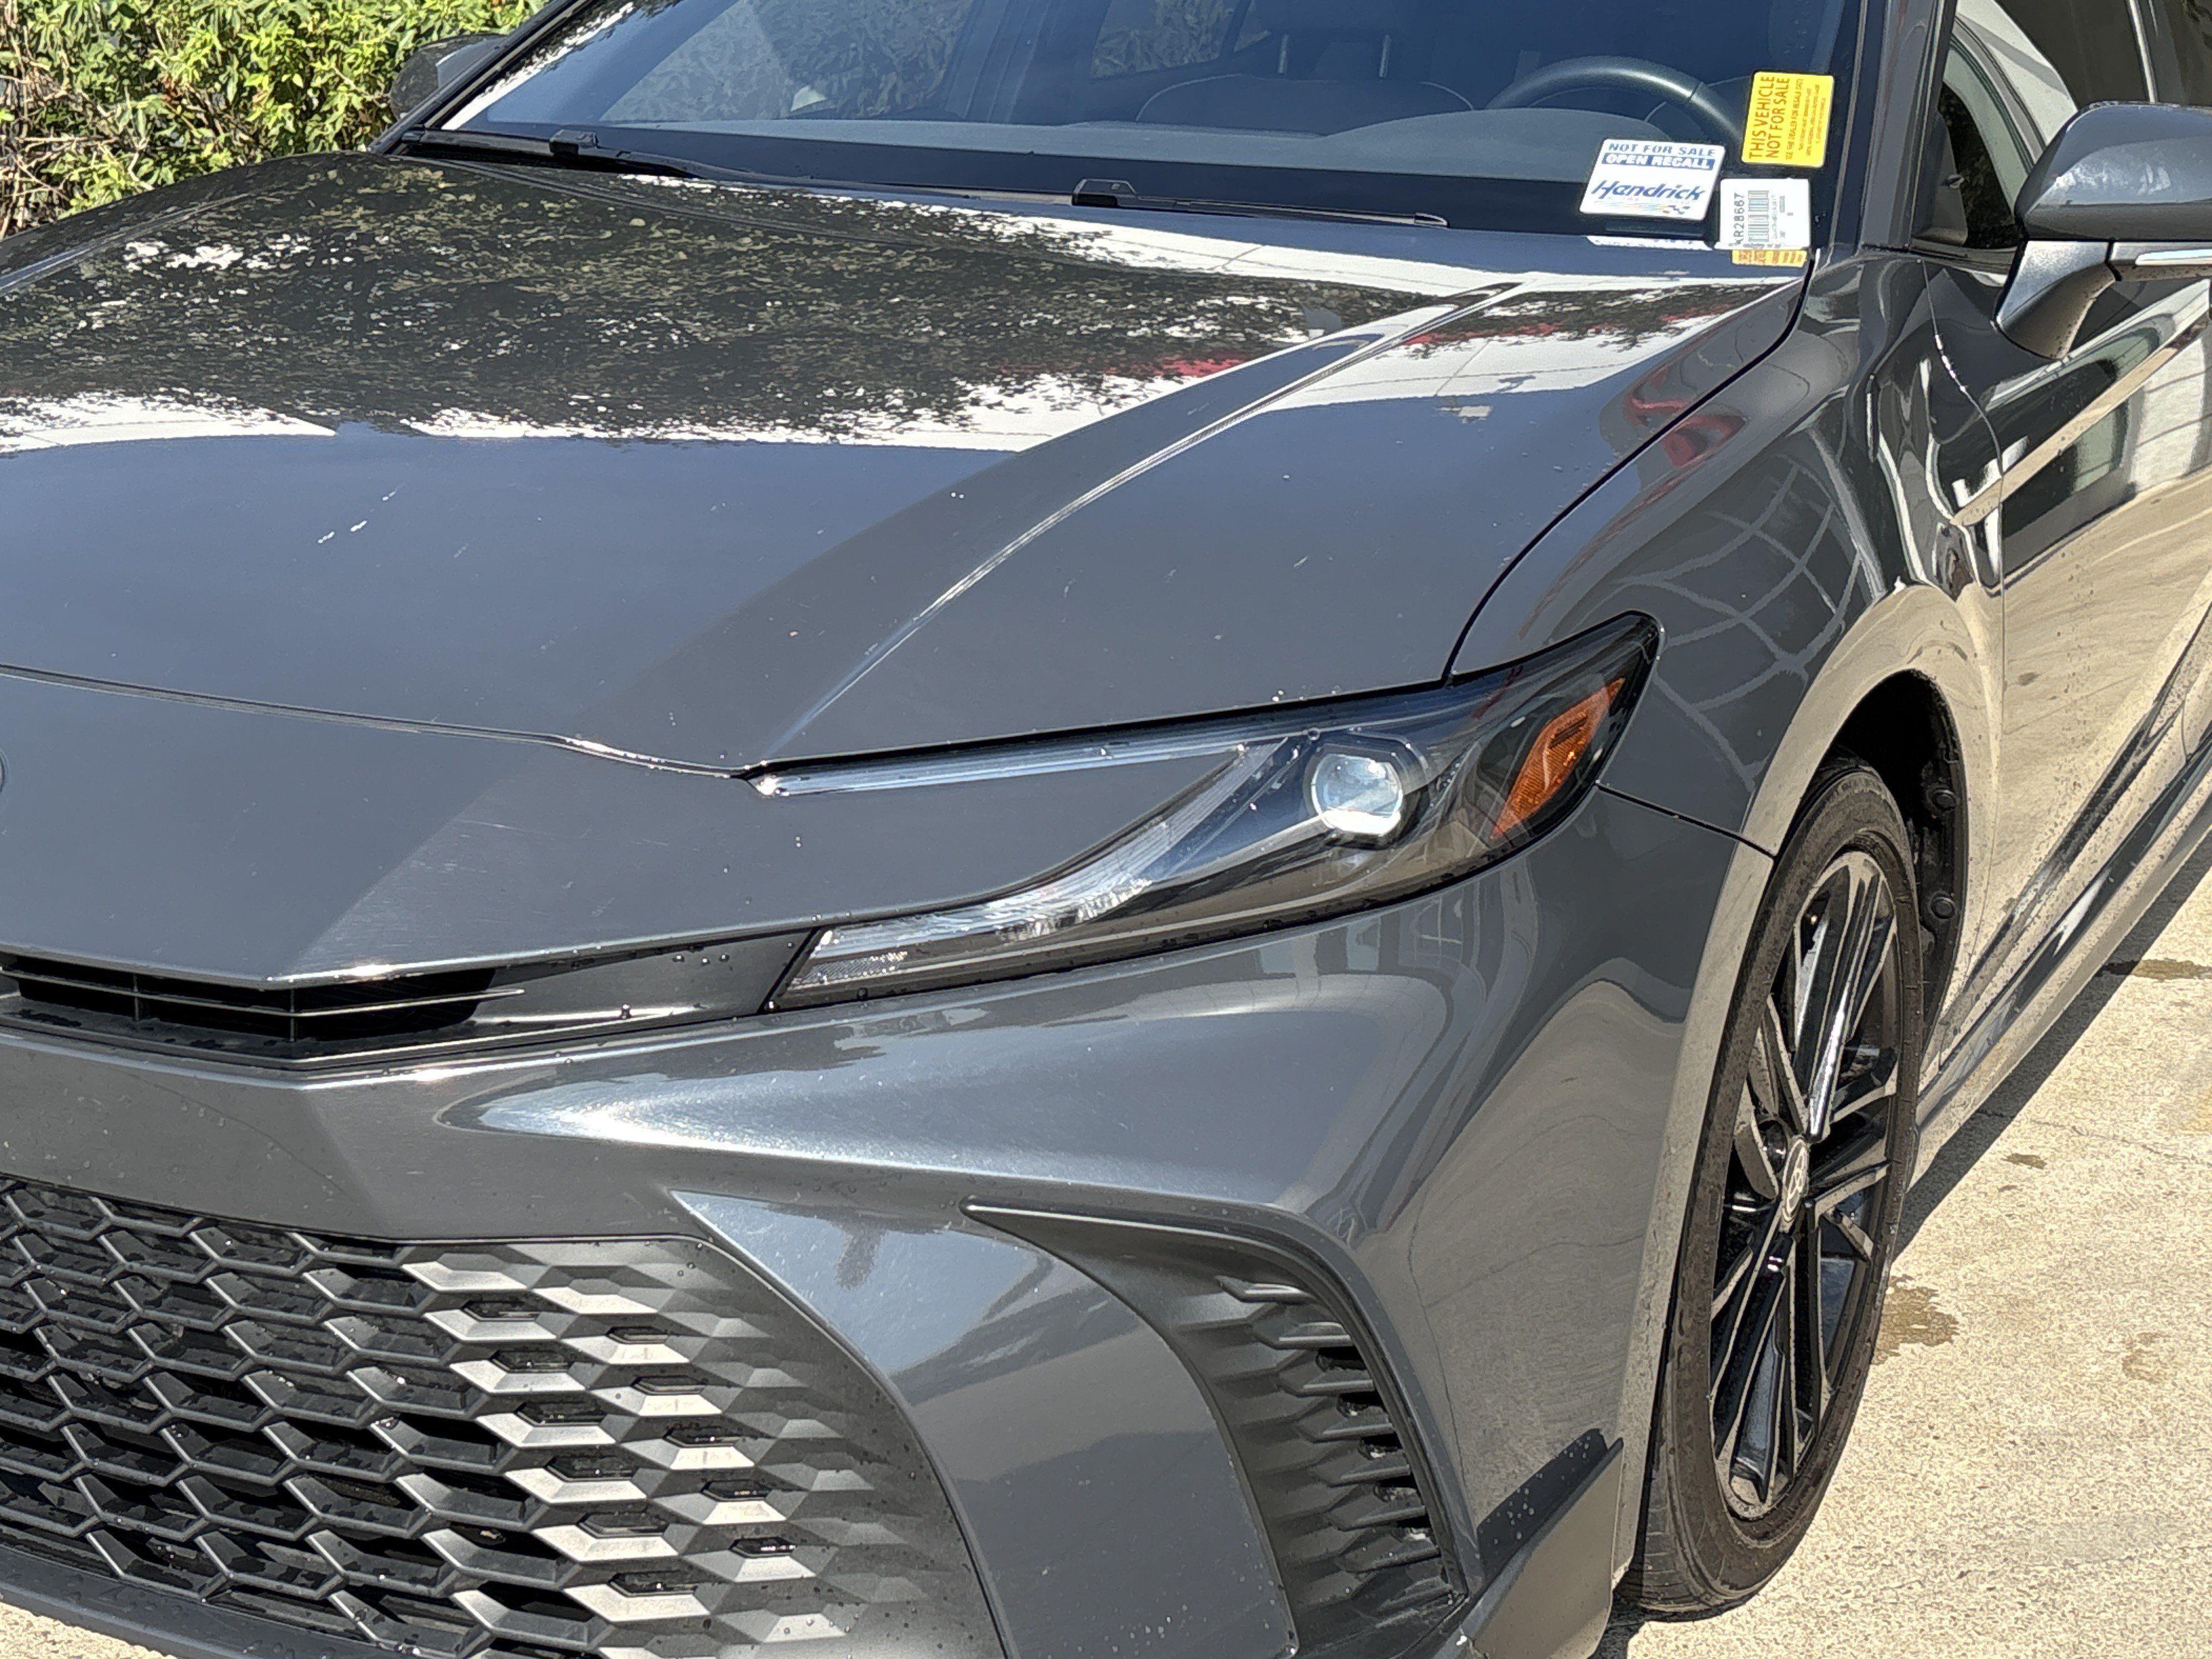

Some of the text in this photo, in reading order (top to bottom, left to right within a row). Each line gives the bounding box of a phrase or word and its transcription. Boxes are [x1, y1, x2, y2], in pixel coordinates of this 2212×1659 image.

[1749, 76, 1775, 159] THIS VEHICLE
[1765, 78, 1790, 158] NOT FOR SALE
[1609, 143, 1716, 156] NOT FOR SALE
[1605, 154, 1711, 169] OPEN RECALL
[1591, 180, 1706, 200] Hendrick
